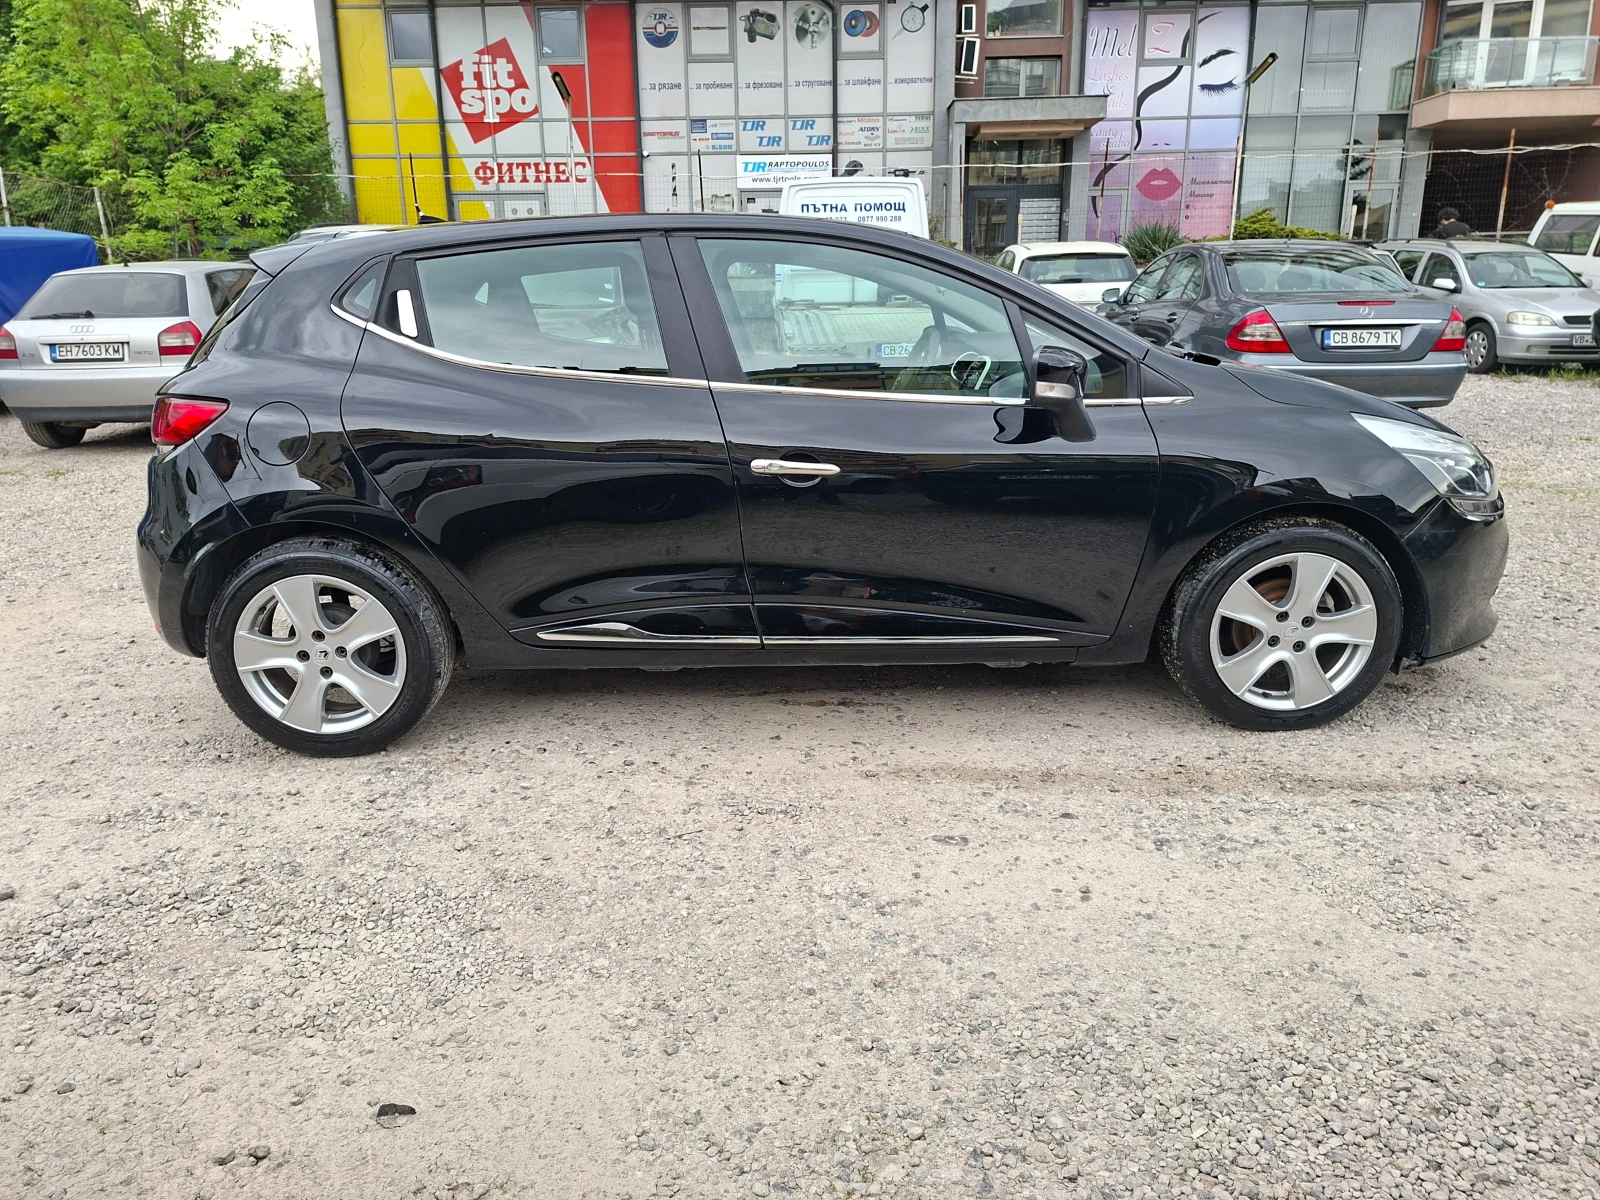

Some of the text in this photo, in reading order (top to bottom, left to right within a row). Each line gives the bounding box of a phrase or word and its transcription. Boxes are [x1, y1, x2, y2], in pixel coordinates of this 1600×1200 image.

[1089, 23, 1138, 59] Mel
[459, 54, 515, 90] fit
[1087, 63, 1130, 83] Lashes
[658, 82, 682, 92] рязане
[702, 80, 733, 92] пробиване
[752, 80, 783, 91] фрезоване
[801, 79, 833, 89] струговане
[852, 76, 882, 87] шлайфане
[894, 76, 933, 86] измервателни
[460, 88, 538, 123] spo
[740, 120, 767, 132] TJR
[790, 119, 816, 131] TJR
[643, 130, 680, 138] SARTORIUS
[806, 134, 832, 146] TJR
[756, 135, 783, 147] TJR
[741, 161, 768, 173] TJR
[767, 160, 830, 169] RAPTOPOULOS
[474, 161, 588, 186] ФИТНЕС
[800, 202, 906, 213] ПЪТНА ПОМОЩ
[1332, 329, 1399, 344] CB 8679 TK
[58, 344, 121, 357] EH 7603 KM
[883, 345, 897, 356] CB
